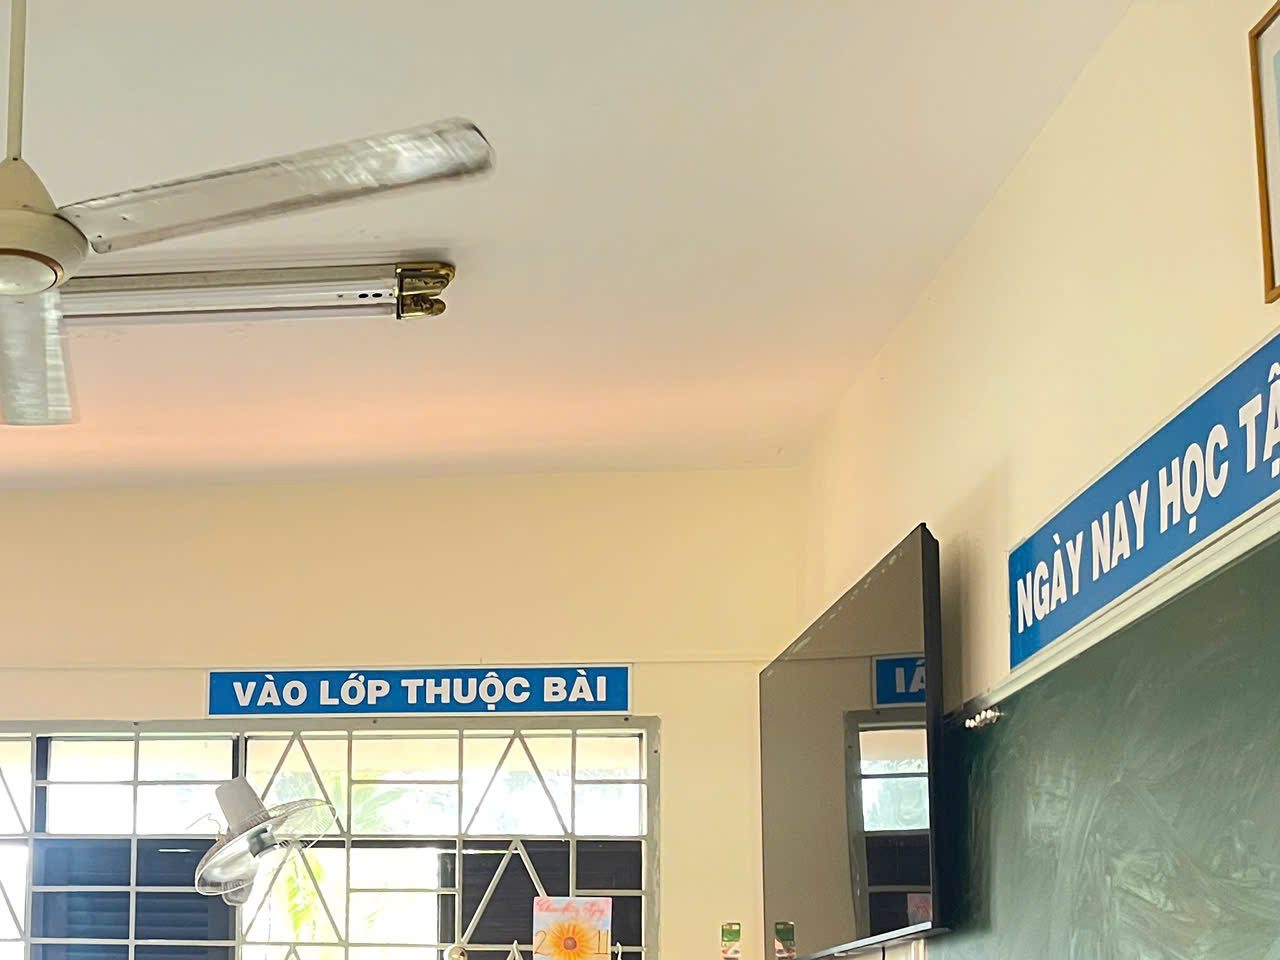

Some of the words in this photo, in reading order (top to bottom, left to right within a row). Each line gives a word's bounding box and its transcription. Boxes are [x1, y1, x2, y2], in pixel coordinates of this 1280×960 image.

[1016, 530, 1084, 634] NGÀY
[1090, 479, 1150, 582] NAY
[1157, 423, 1229, 535] HỌC
[232, 673, 308, 708] VÀO
[319, 672, 391, 706] LỚP
[400, 670, 531, 711] THUỘC
[543, 668, 607, 703] BÀI
